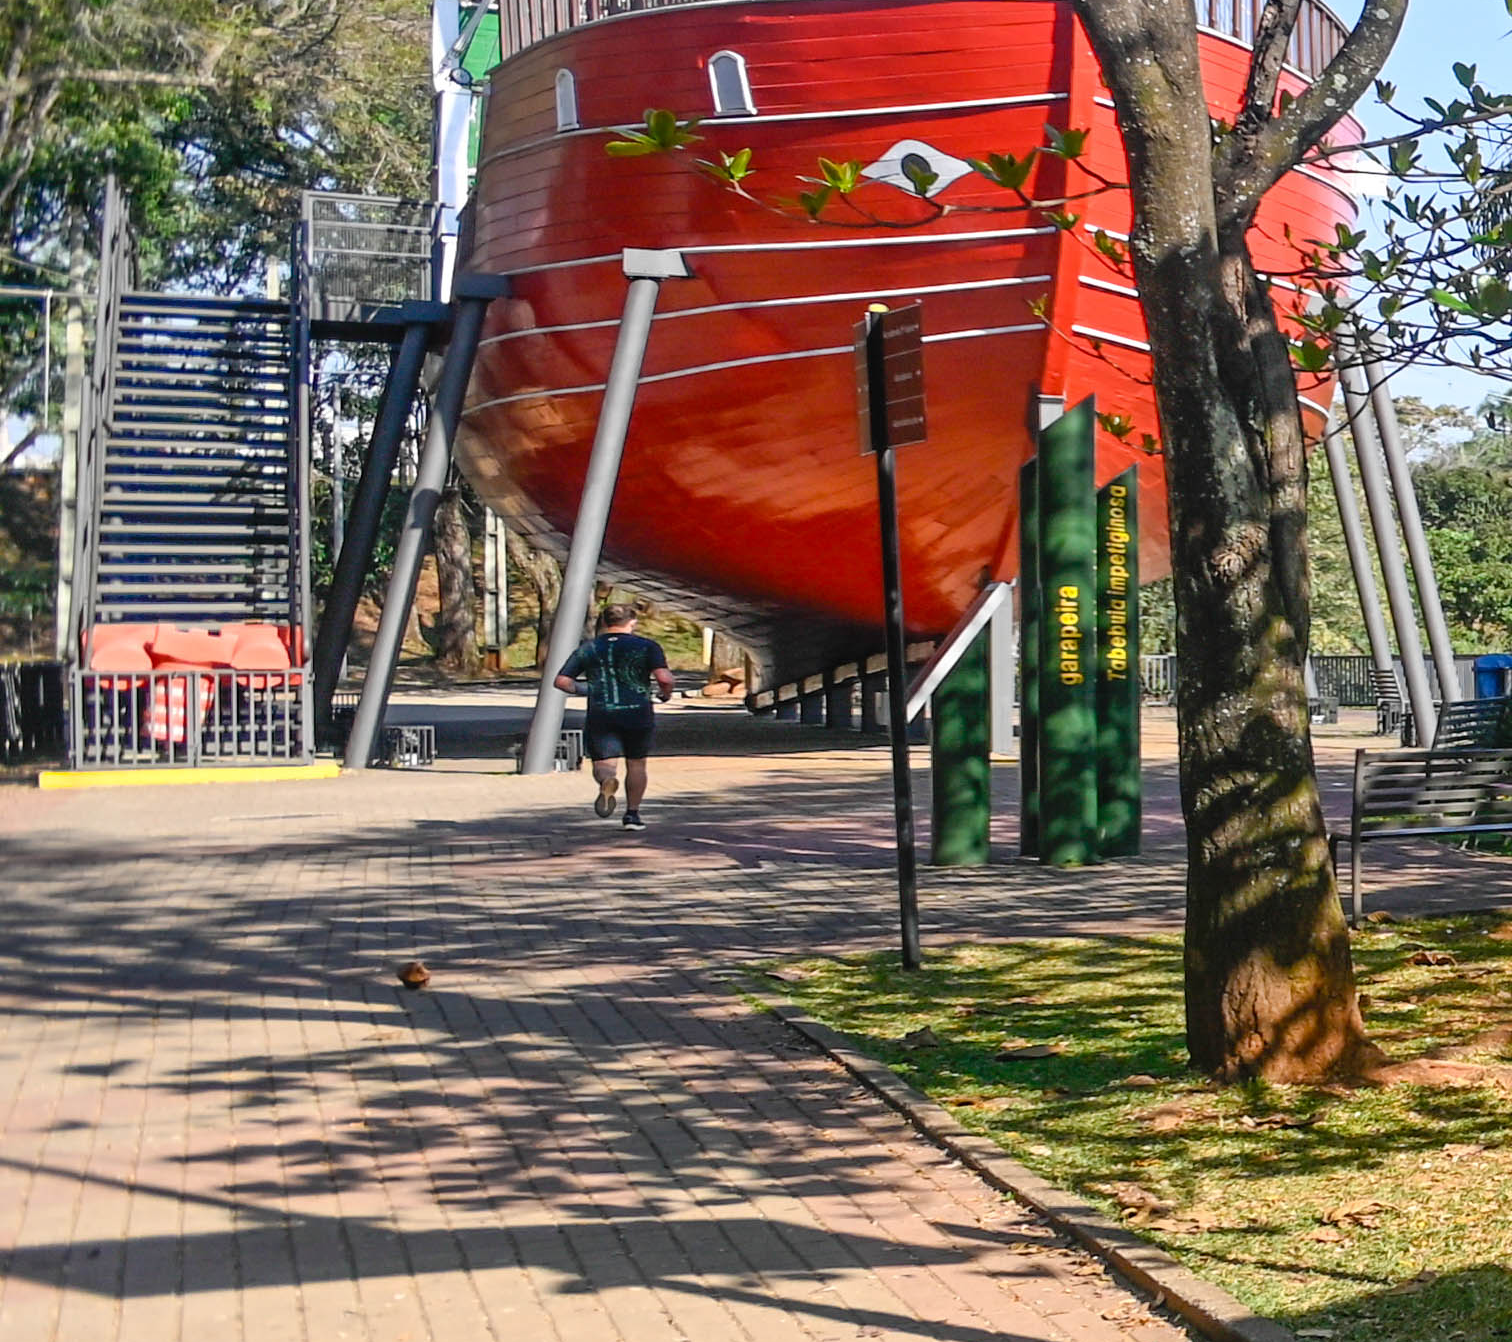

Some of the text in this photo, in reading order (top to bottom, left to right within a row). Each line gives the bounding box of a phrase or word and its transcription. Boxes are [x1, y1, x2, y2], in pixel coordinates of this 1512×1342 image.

[1055, 585, 1084, 686] garapeira
[1105, 484, 1130, 682] Tabebuia impetiginosa
